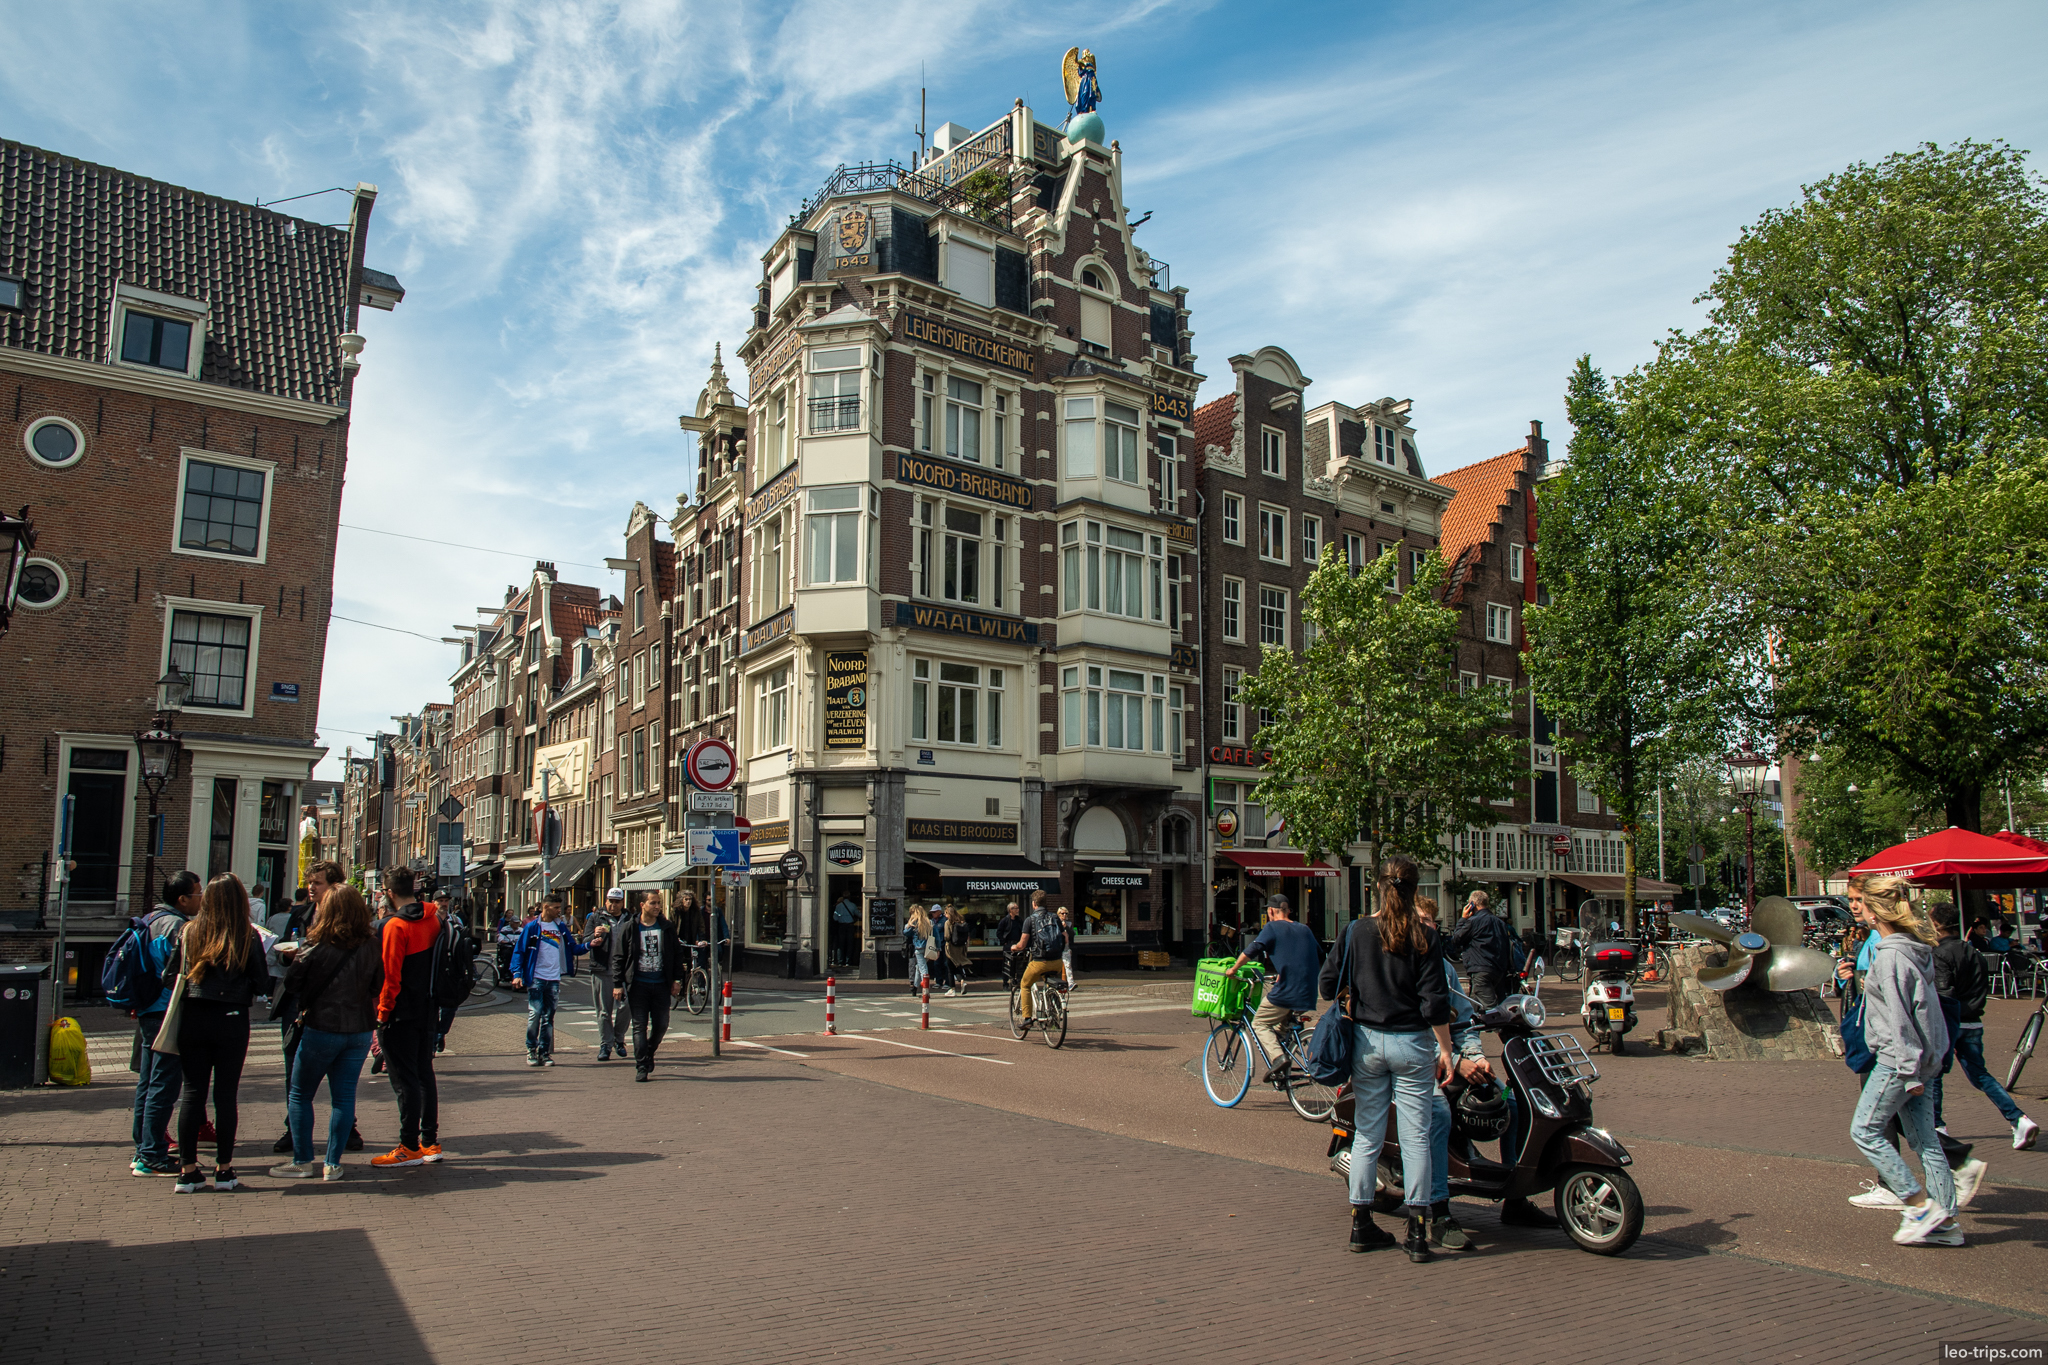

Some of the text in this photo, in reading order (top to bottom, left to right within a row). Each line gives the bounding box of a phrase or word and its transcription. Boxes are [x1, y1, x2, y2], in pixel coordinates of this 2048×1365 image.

[836, 255, 869, 268] 1843
[904, 315, 1034, 373] LEVENSVERZEKERING
[1154, 393, 1188, 418] 1843
[901, 457, 1032, 506] NOORD-BRABAND
[746, 612, 793, 650] WAALWIJK
[914, 606, 1027, 641] WAALWIJK
[827, 672, 867, 691] BRABAND
[826, 709, 866, 719] VERZEKERING
[843, 718, 866, 728] LEVEN
[1211, 746, 1254, 765] CAFE
[912, 823, 1015, 839] KAAS EN BROODJES
[829, 849, 861, 859] WALS KAAS
[1894, 869, 1914, 877] BIER
[966, 881, 1039, 890] FRESH SANDWICHES
[1101, 877, 1143, 886] CHEESE CAKE
[1200, 974, 1220, 988] Uber
[1197, 988, 1219, 1004] Eats
